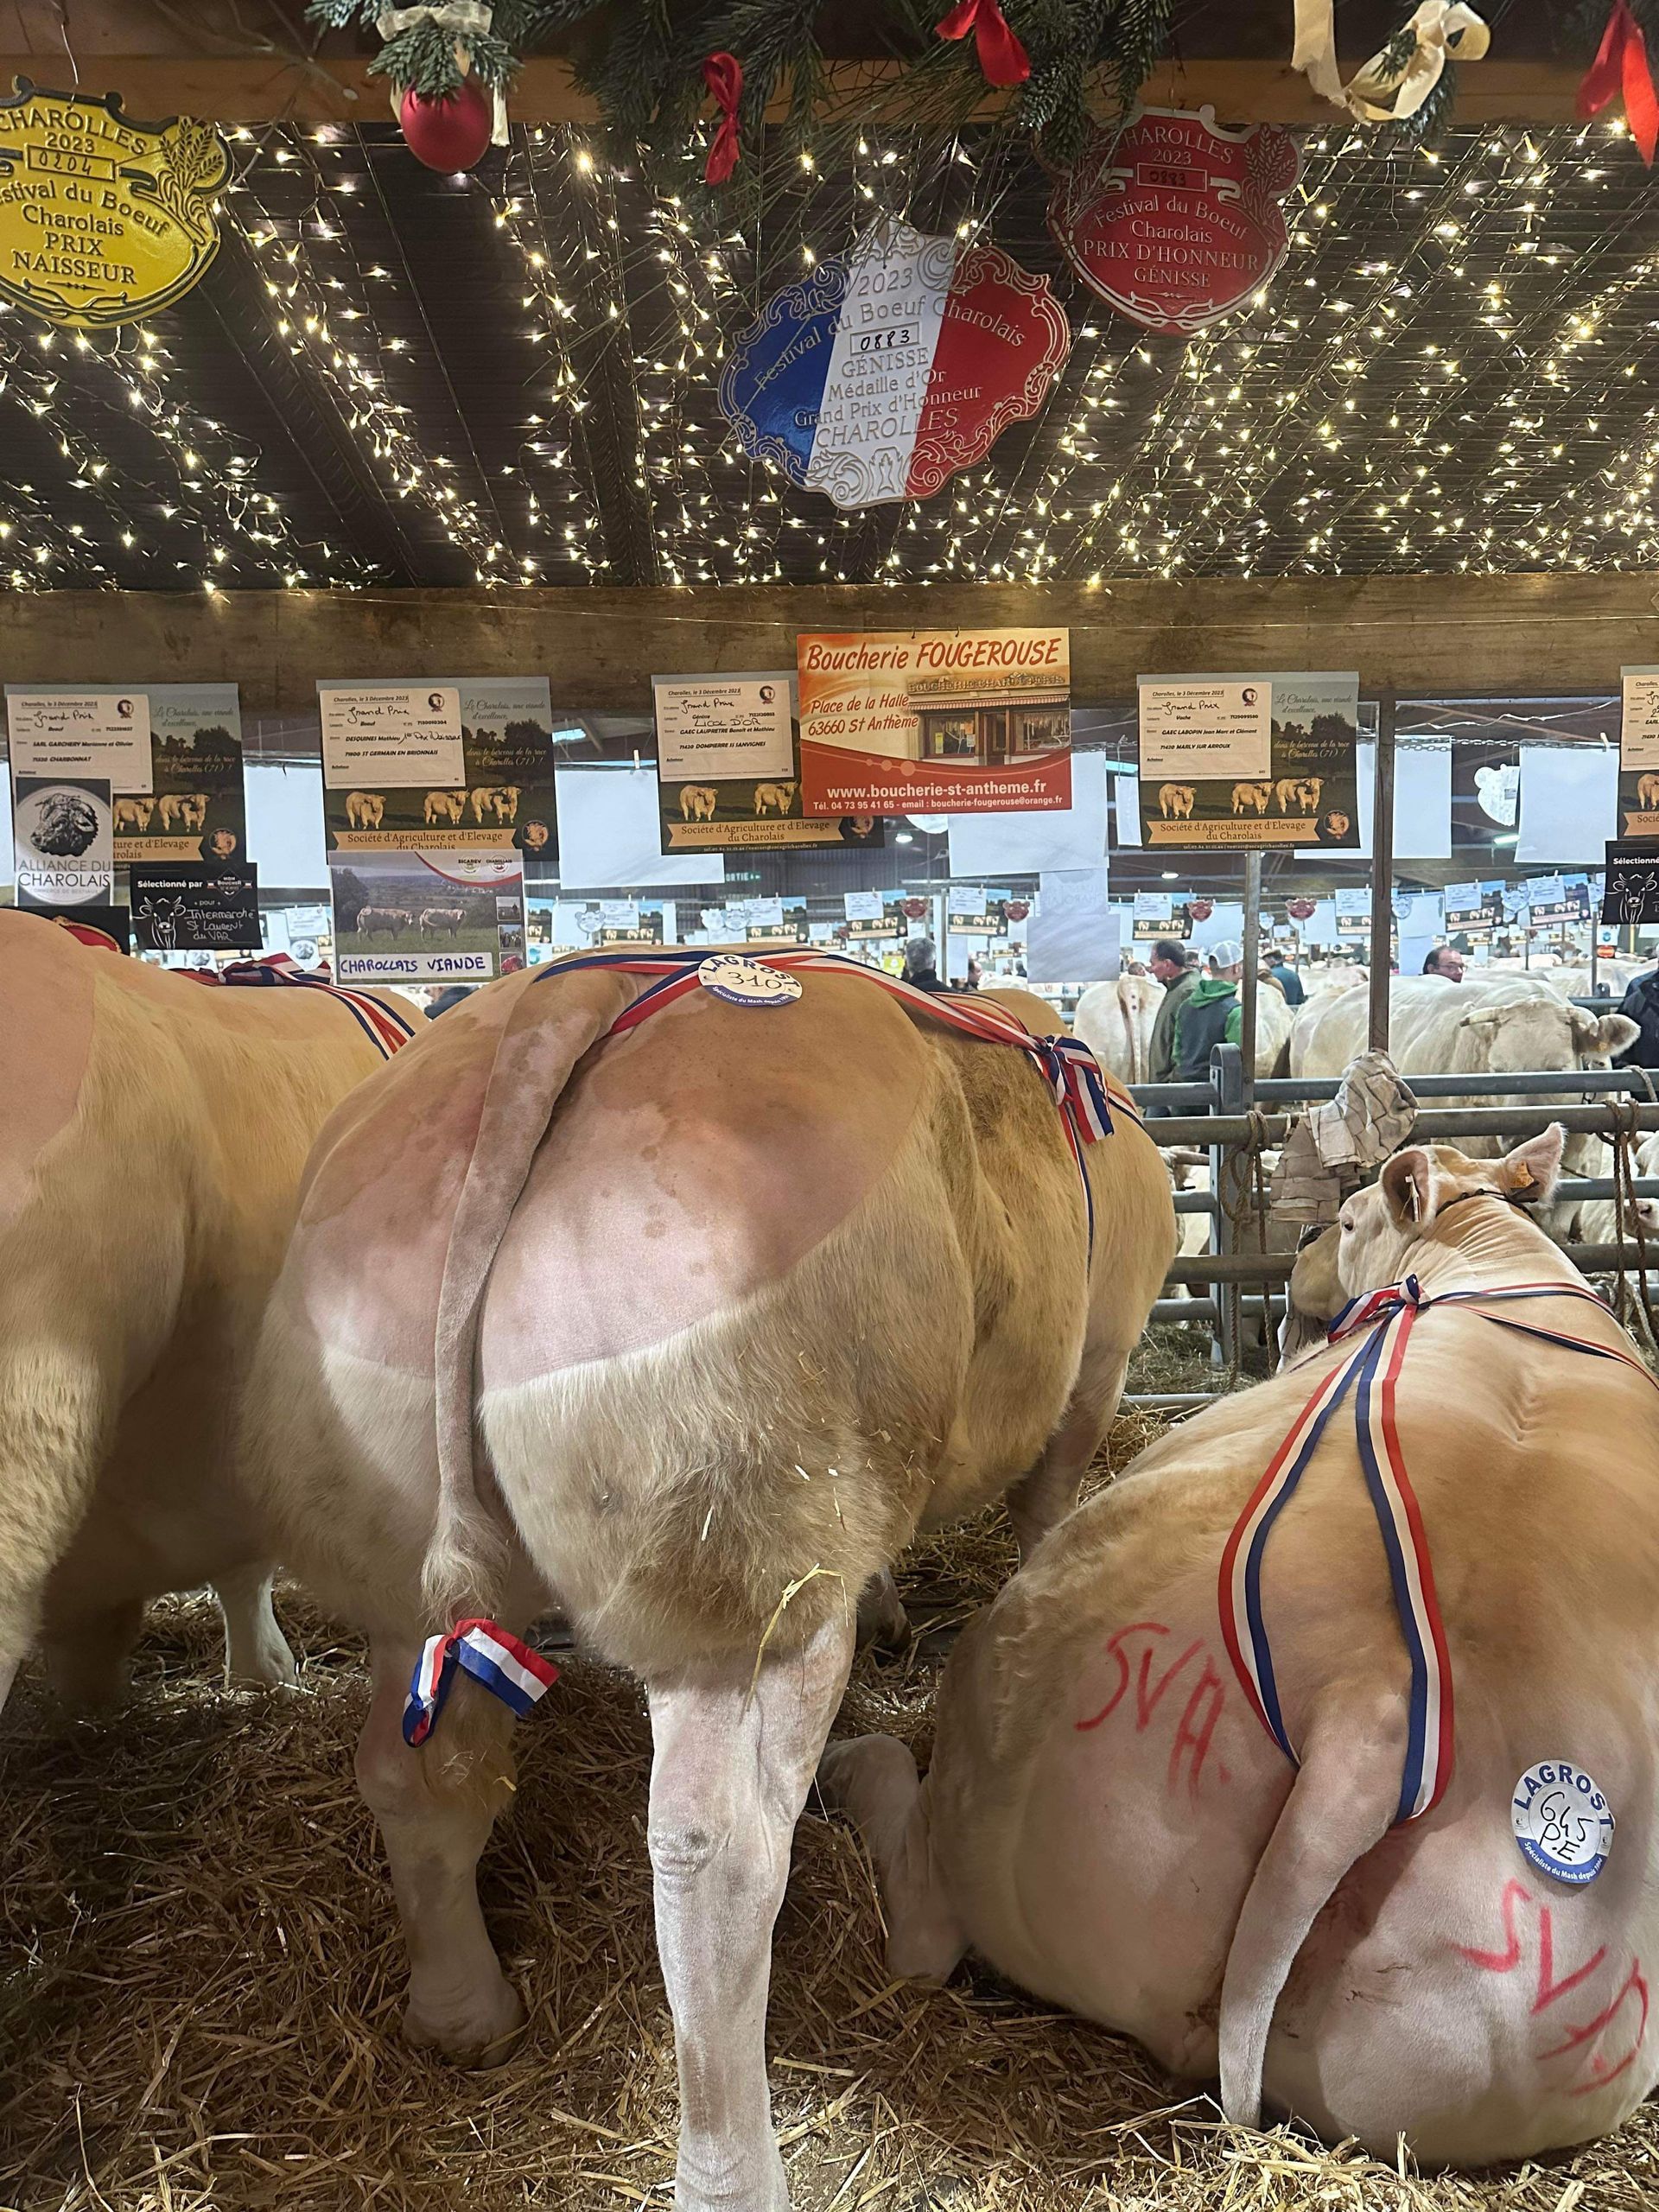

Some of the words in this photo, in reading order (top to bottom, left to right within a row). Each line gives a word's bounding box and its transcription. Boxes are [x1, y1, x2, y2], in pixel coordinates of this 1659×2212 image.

[0, 107, 147, 156] CHAROLLES
[46, 131, 95, 153] 2023
[1124, 127, 1235, 164] HAROLLES
[1153, 149, 1192, 165] 2023
[39, 150, 92, 175] 0204
[22, 204, 124, 236] Charolais
[65, 181, 92, 203] du
[101, 189, 170, 238] Boeuf
[1095, 194, 1159, 227] Festival
[1166, 196, 1187, 213] du
[1196, 201, 1249, 240] Boeuf
[44, 231, 105, 257] PRIX
[1131, 220, 1212, 244] Charolais
[12, 250, 137, 284] NAISSEUR
[1084, 240, 1128, 258] PRIX
[1137, 244, 1258, 270] D'HONNEUR
[857, 271, 912, 297] 2023
[1134, 264, 1211, 288] GÉNISSE
[753, 330, 823, 391] Festival
[828, 315, 853, 336] du
[861, 296, 925, 324] Boeuf
[932, 296, 1027, 347] Charolais
[860, 329, 911, 351] 0883
[842, 346, 929, 378] GÉNISSE
[828, 377, 899, 403] Médaille
[906, 369, 947, 390] d'Or
[794, 404, 844, 427] Grand
[849, 398, 882, 419] Prix
[888, 385, 982, 413] d'Honneur
[816, 407, 960, 448] CHAROLLES
[807, 641, 908, 671] Boucherie
[916, 638, 1061, 668] FOUGEROUSE
[347, 707, 384, 723] Grand
[681, 700, 710, 714] Grand
[810, 699, 842, 714] Place
[847, 696, 861, 711] de
[865, 696, 875, 709] la
[880, 693, 909, 708] Halle
[1161, 702, 1196, 715] Grand
[809, 720, 845, 735] 63660
[849, 717, 865, 733] St
[868, 714, 918, 731] Anthème
[827, 779, 1046, 798] www.boucherie-st-antheme.fr
[813, 801, 829, 810] Tél.
[883, 800, 894, 809] 65
[901, 799, 924, 808] email
[931, 795, 1063, 807] boucherie-fougerouse@orange.fr
[348, 833, 382, 842] Société
[384, 832, 445, 844] d'Agriculture
[459, 831, 502, 842] d'Elevage
[681, 825, 713, 835] Société
[716, 823, 774, 835] d'Agriculture
[787, 821, 830, 830] d'Elevage
[728, 834, 740, 842] du
[741, 832, 785, 842] Charolais
[1160, 823, 1192, 832] Société
[1194, 822, 1251, 833] d'Agriculture
[1264, 820, 1306, 831] d'Elevage
[1219, 831, 1262, 840] Charolais
[146, 839, 189, 850] d'Elevage
[20, 860, 86, 872] ALLIANCE
[91, 860, 111, 872] DU
[18, 873, 111, 887] CHAROLAIS
[340, 959, 418, 974] CHAROLLAIS
[427, 957, 486, 972] VIANDE
[701, 956, 800, 988] LAGROST
[728, 971, 782, 989] 310
[1514, 1764, 1614, 1830] LAGROST
[1541, 1791, 1594, 1842] 645
[1524, 1841, 1551, 1872] Spécialiste
[1552, 1867, 1560, 1876] du
[1560, 1871, 1578, 1879] Mash
[1579, 1868, 1596, 1880] depuis
